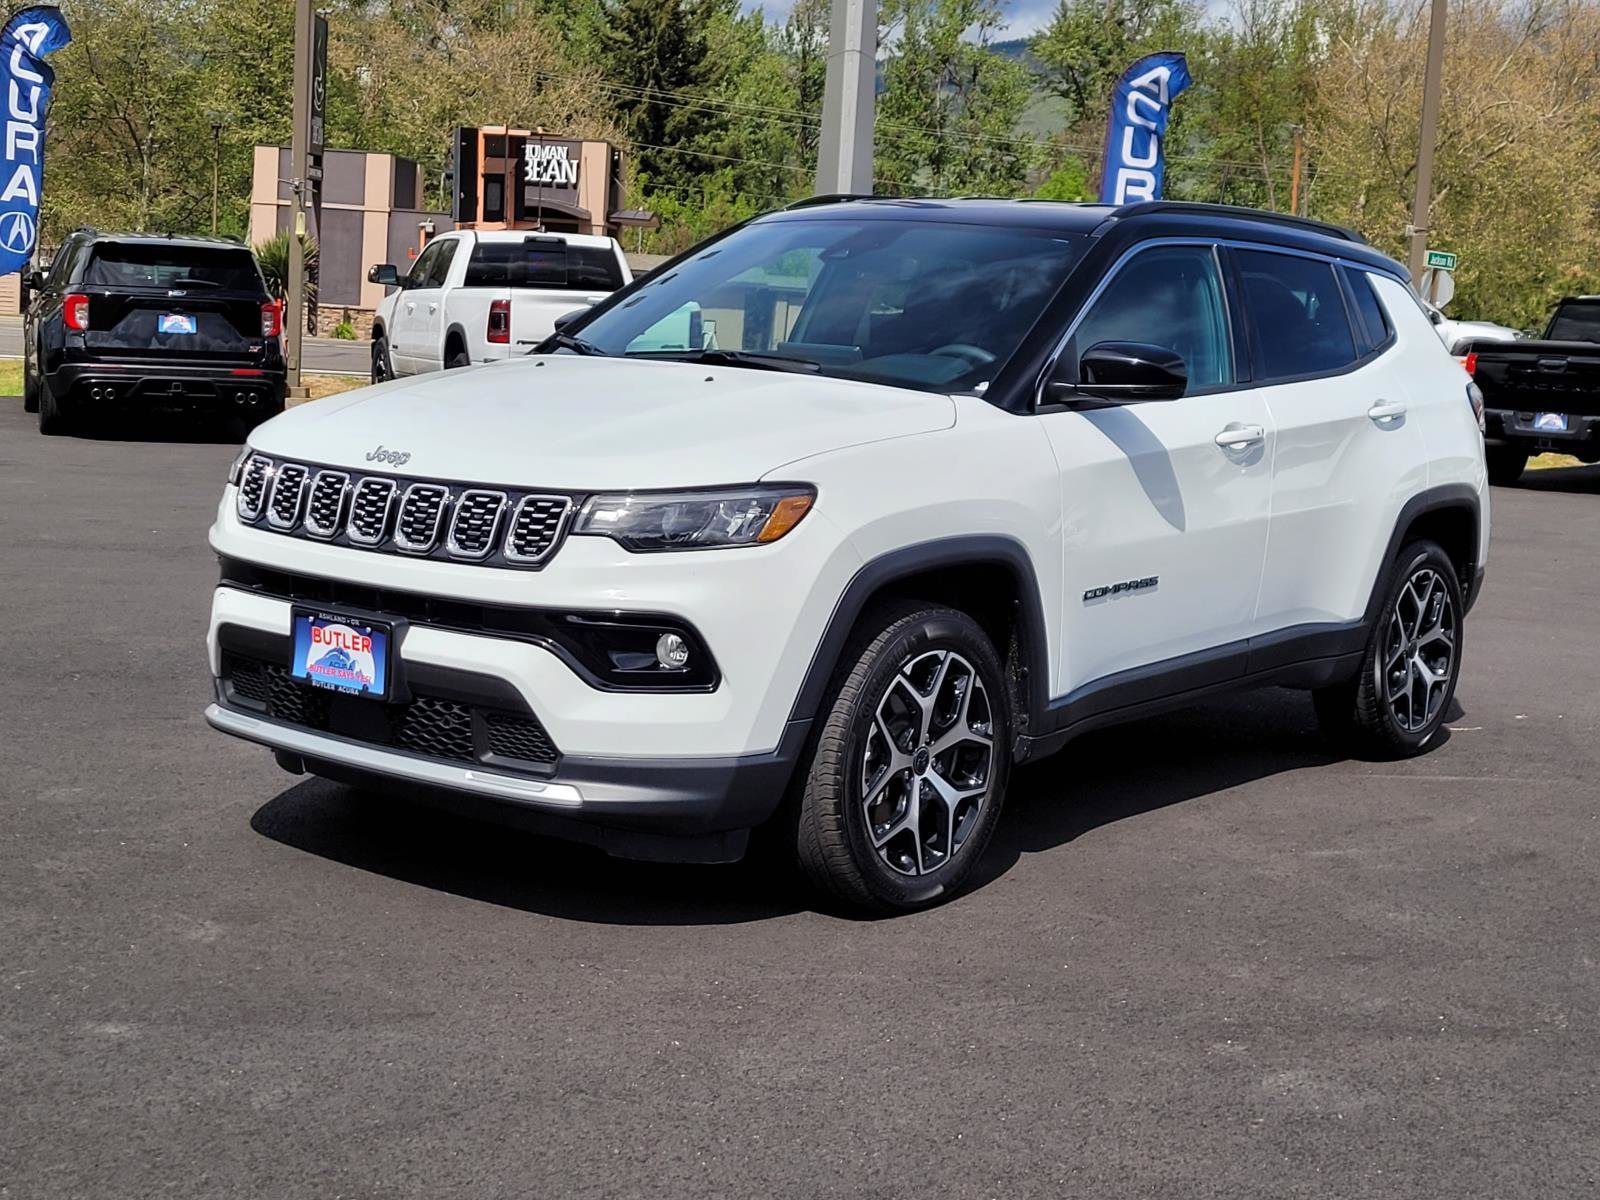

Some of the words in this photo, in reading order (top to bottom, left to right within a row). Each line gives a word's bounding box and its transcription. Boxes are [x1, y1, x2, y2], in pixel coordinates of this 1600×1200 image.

[1, 22, 50, 207] ACURA
[366, 445, 411, 468] Jeep
[1083, 576, 1159, 602] COMPASS
[319, 613, 346, 623] ASHLAND
[312, 627, 372, 653] BUTLER
[312, 681, 336, 690] BUTLER
[338, 686, 359, 695] ACURA
